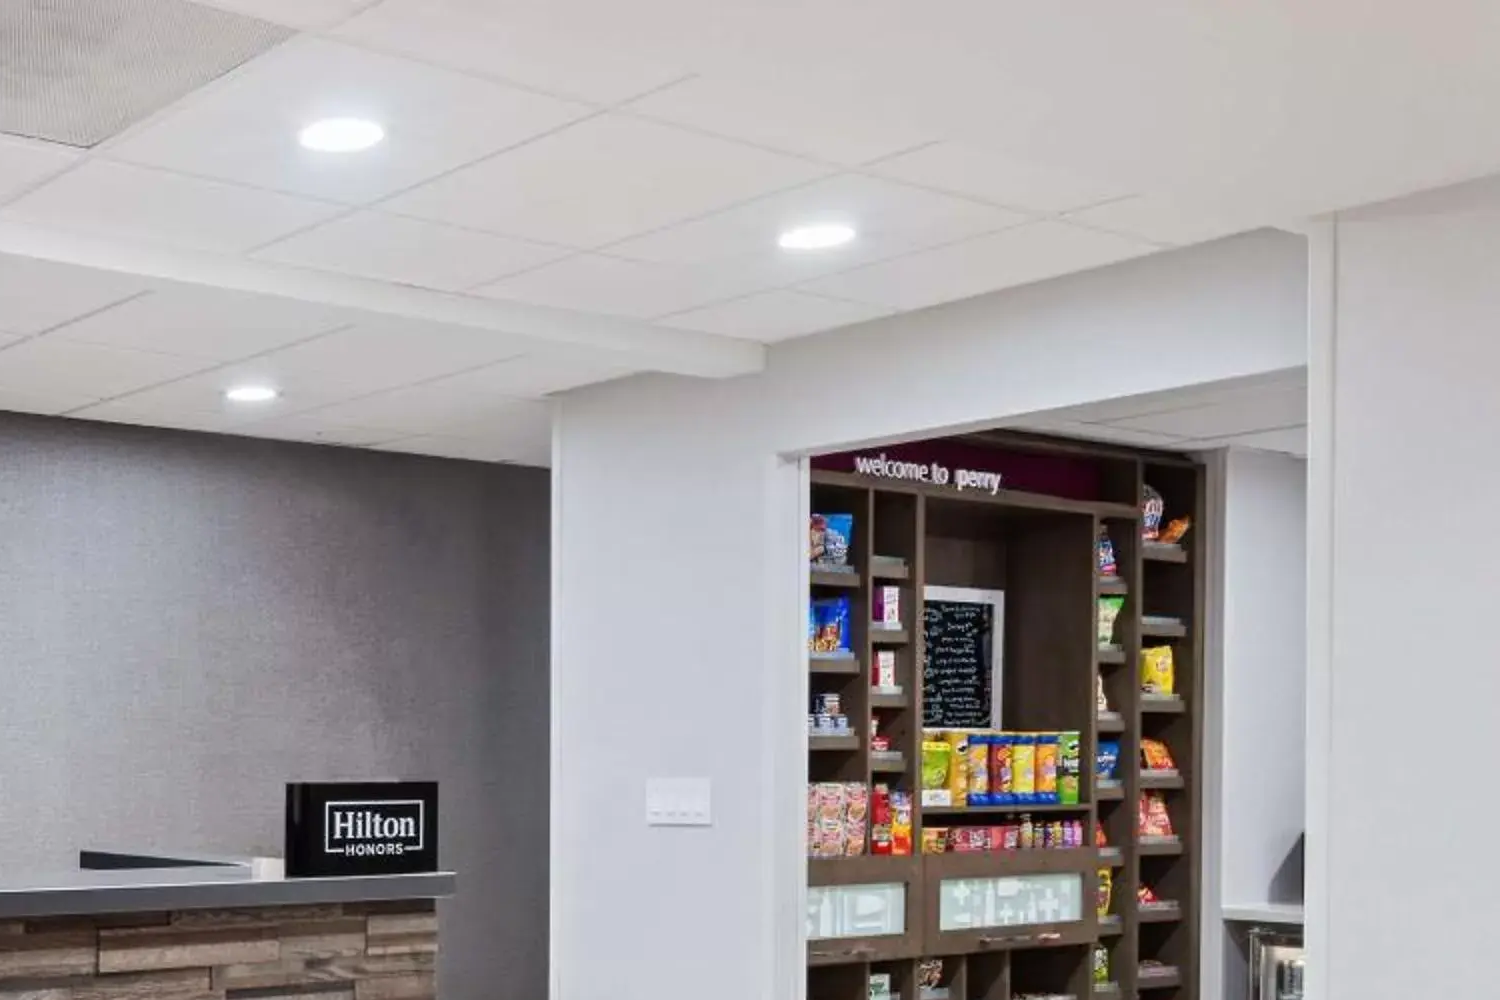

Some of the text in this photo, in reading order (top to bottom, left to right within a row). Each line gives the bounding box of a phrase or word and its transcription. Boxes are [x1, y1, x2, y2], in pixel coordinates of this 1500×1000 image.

[855, 453, 1002, 496] welcome to perry
[333, 811, 416, 839] Hilton
[345, 843, 404, 856] HONORS
